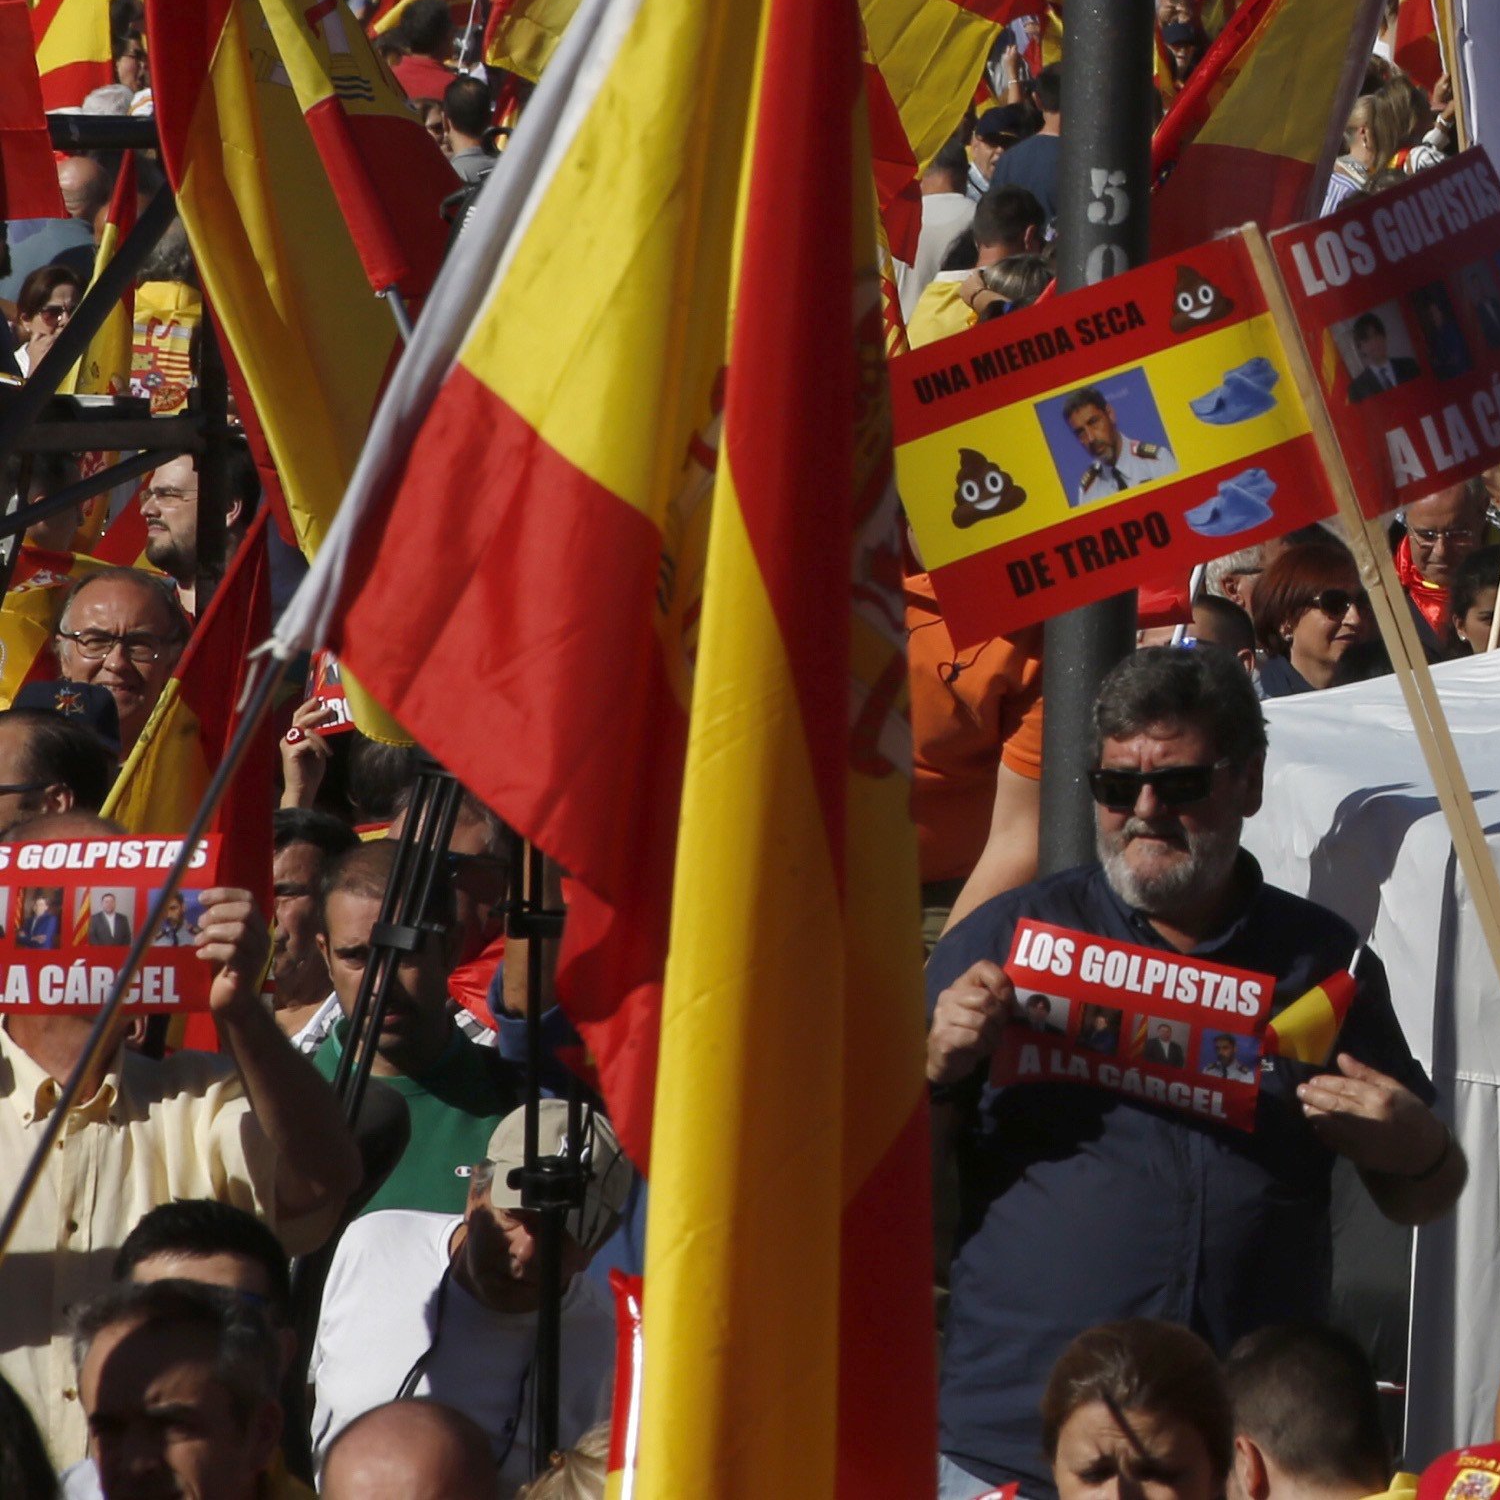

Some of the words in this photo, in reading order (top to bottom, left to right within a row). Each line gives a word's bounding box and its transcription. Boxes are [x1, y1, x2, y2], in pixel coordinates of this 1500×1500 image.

[1290, 220, 1377, 297] LOS
[912, 366, 971, 406] UNA
[970, 325, 1075, 384] MIERDA
[1074, 300, 1147, 347] SECA
[1385, 426, 1428, 489] A
[1420, 402, 1481, 473] LA
[1006, 550, 1056, 599] DE
[1053, 510, 1172, 580] TRAPO
[17, 839, 209, 871] GOLPISTAS
[1013, 928, 1076, 977] LOS
[1079, 944, 1263, 1018] GOLPISTAS
[1017, 1043, 1042, 1076] A
[1050, 1048, 1091, 1080] LA
[1098, 1063, 1228, 1119] CÁRCEL
